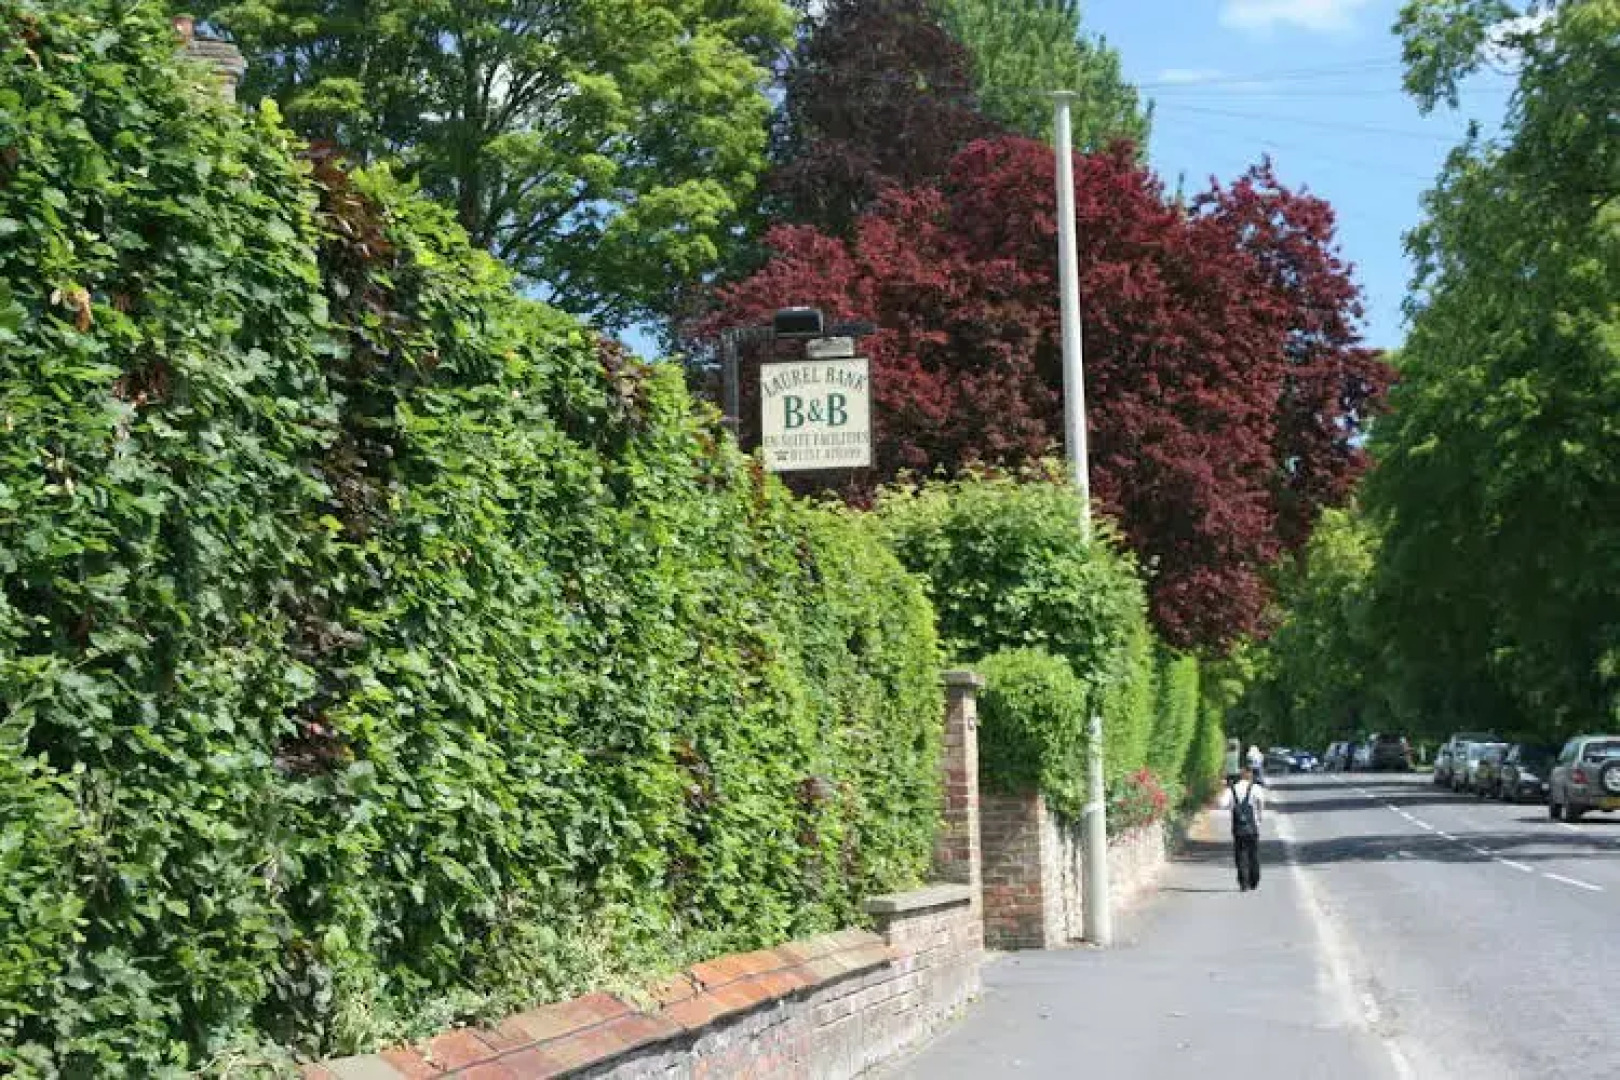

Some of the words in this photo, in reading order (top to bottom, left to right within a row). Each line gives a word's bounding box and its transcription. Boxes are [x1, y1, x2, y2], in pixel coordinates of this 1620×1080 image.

[763, 366, 821, 397] LAUREL
[825, 366, 867, 393] BANK
[784, 393, 848, 429] B&B
